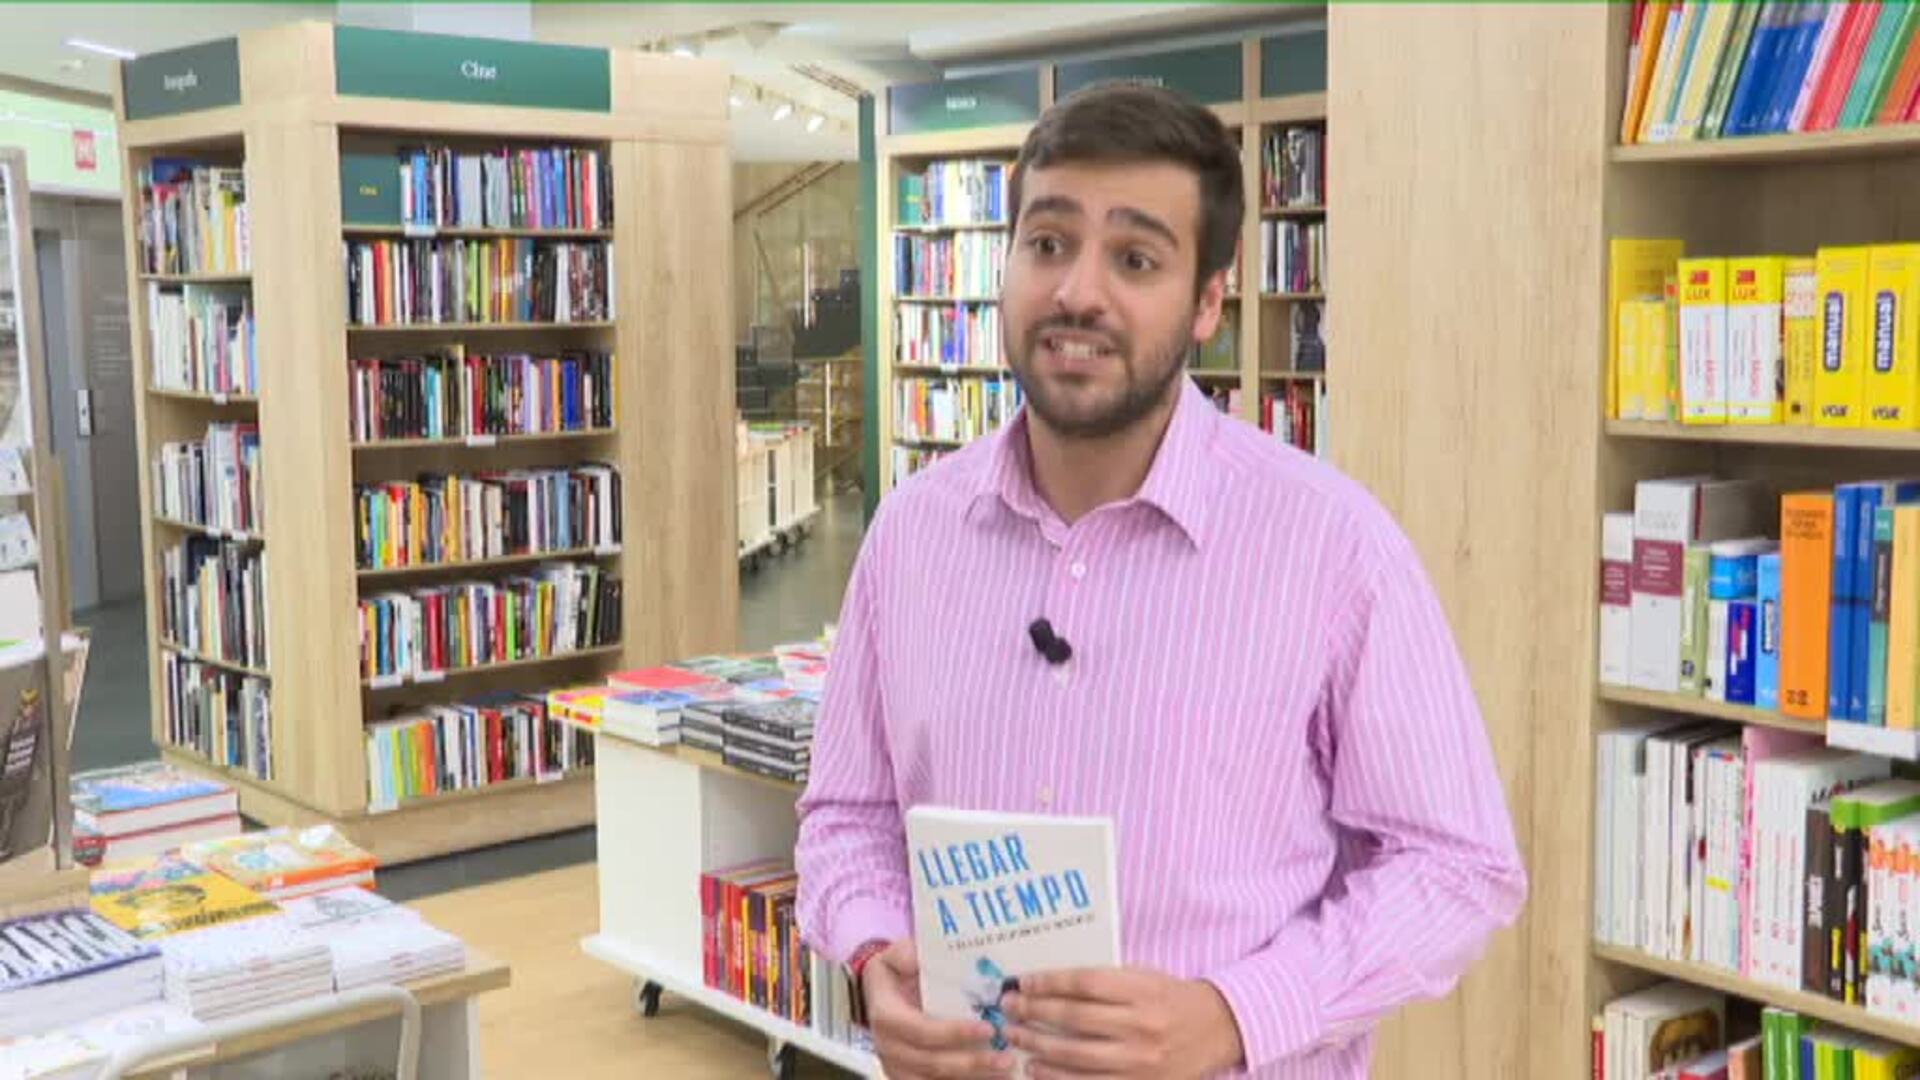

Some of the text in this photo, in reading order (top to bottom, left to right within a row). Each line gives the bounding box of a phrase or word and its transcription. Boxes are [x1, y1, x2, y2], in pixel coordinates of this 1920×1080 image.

[918, 833, 1030, 888] LLEGAR
[936, 869, 1091, 935] A TIEMPO
